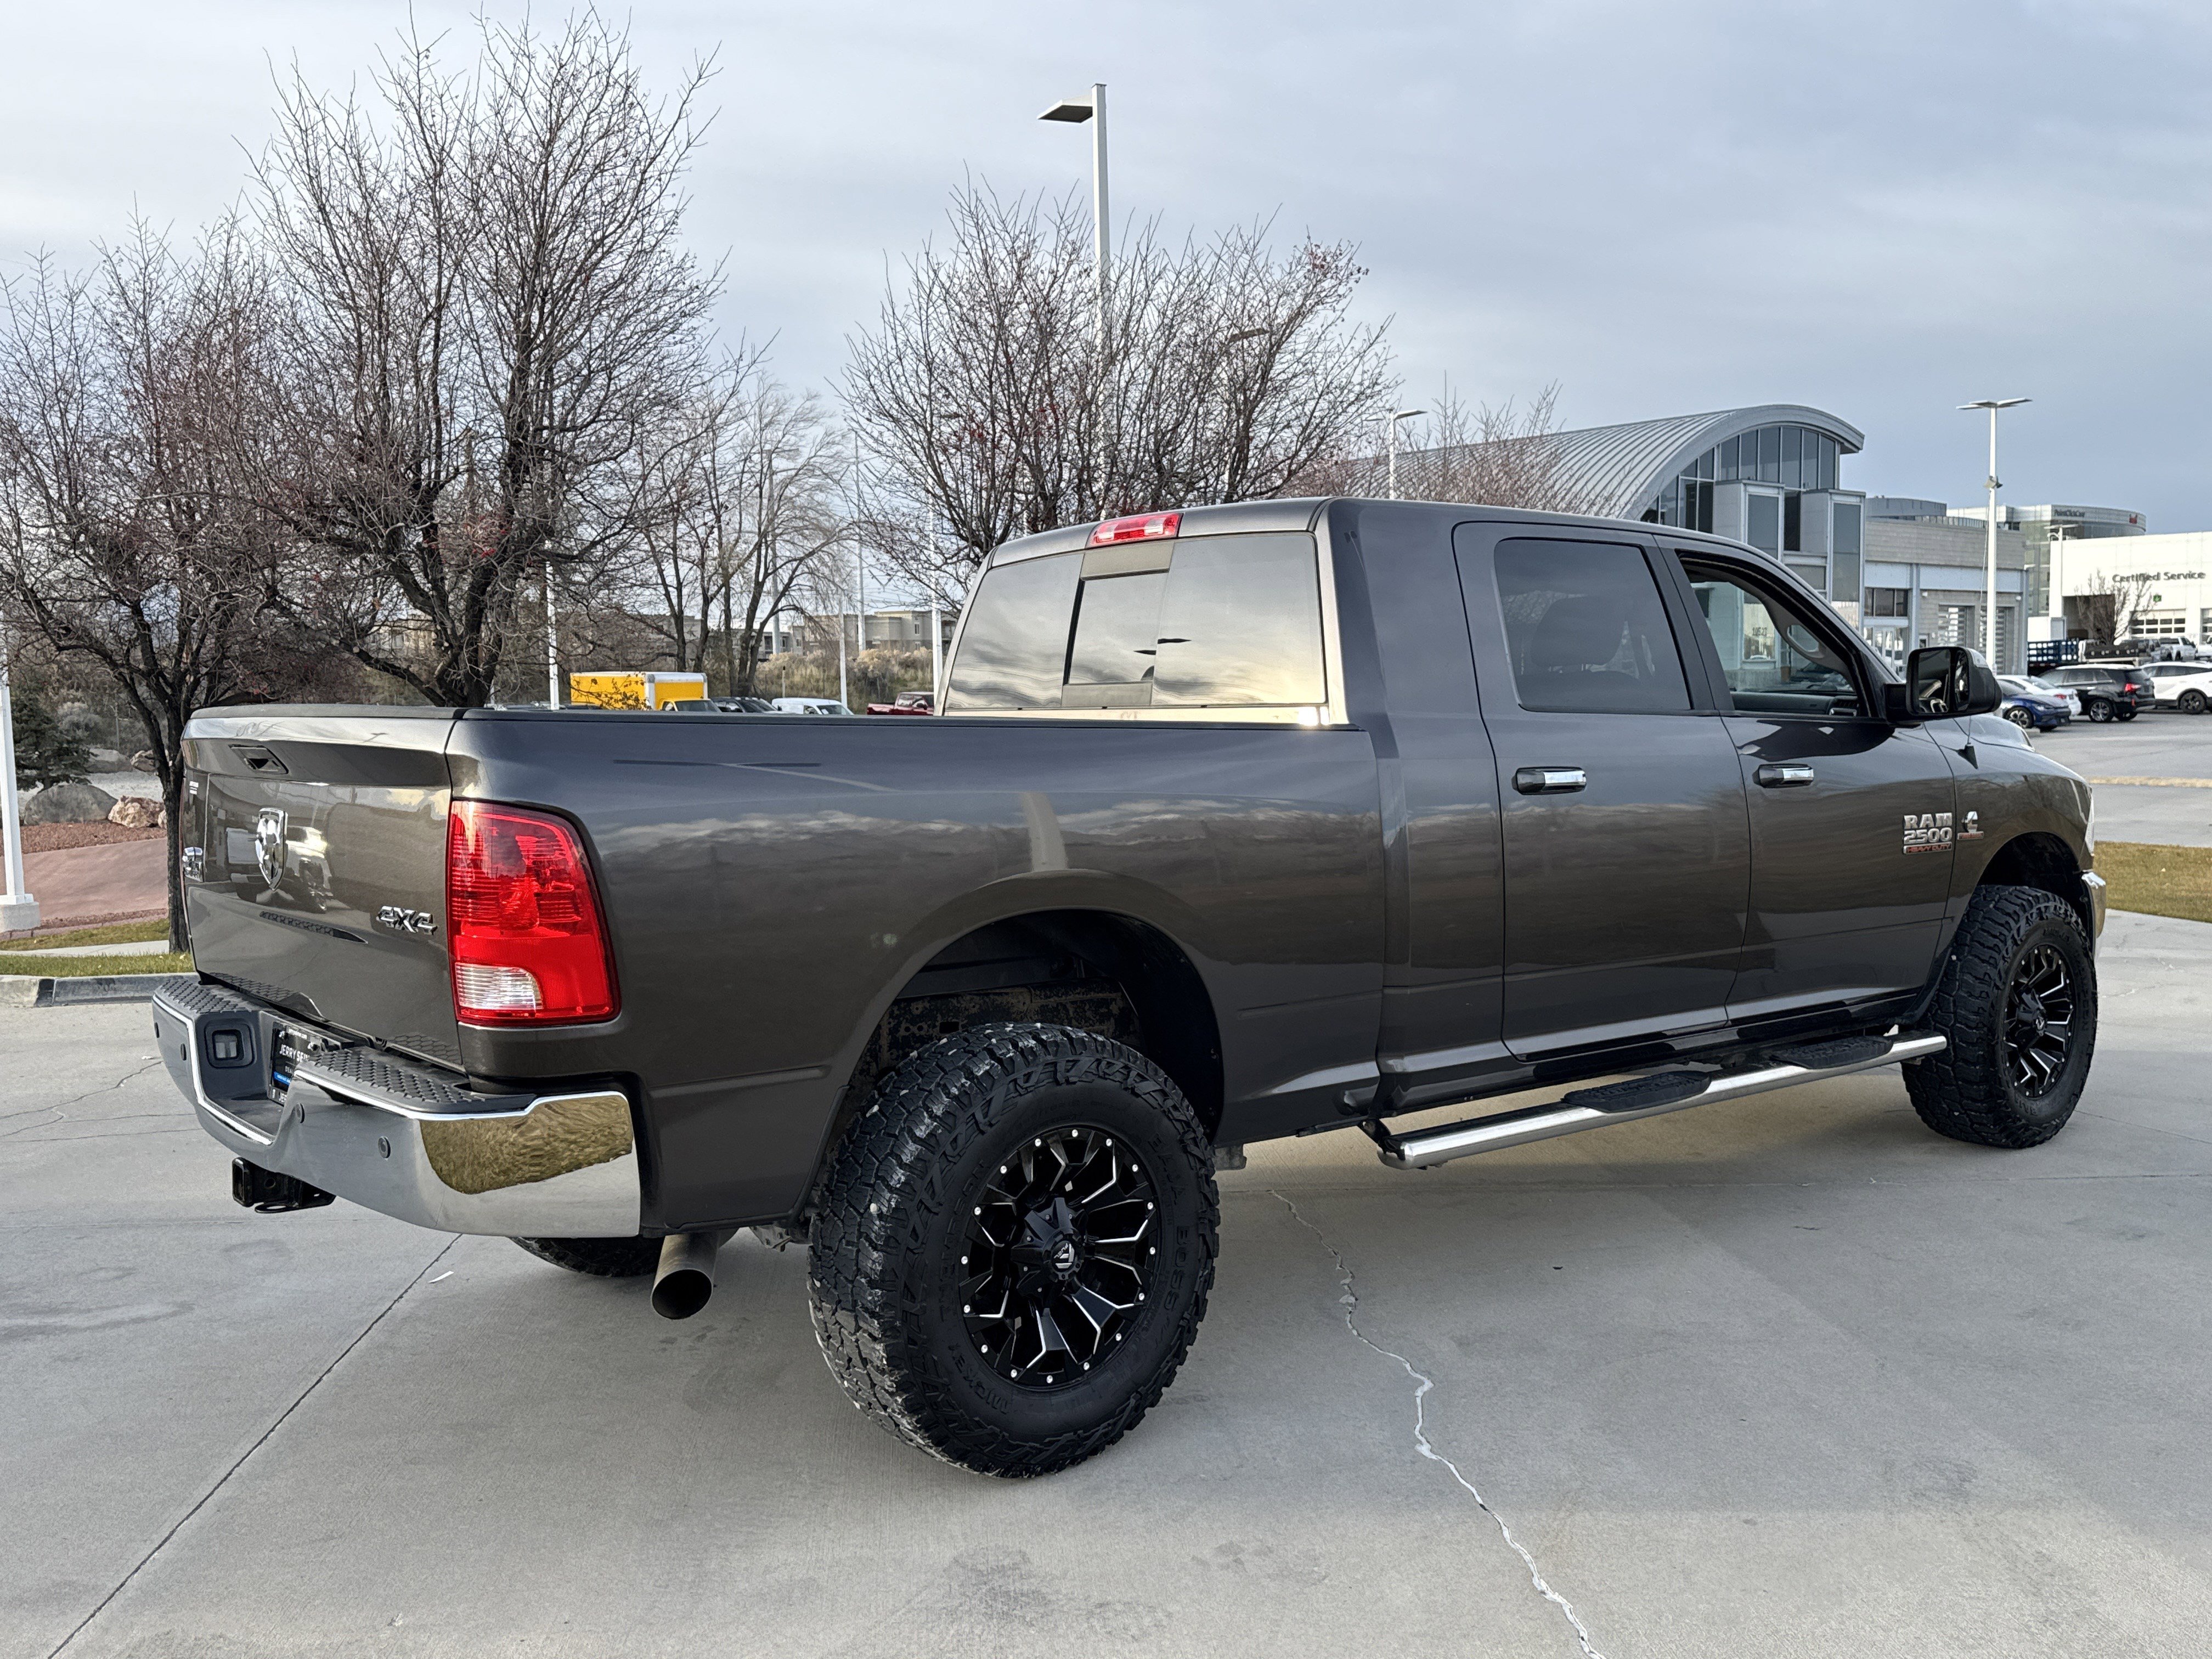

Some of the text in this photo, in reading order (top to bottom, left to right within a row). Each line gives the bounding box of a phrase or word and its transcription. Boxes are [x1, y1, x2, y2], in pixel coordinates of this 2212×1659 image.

[2112, 570, 2206, 583] Certified Service
[1903, 812, 1953, 829] RAM
[1903, 827, 1953, 844] 2500
[1907, 843, 1951, 854] HEAVY DUTY
[280, 1043, 297, 1060] JERRY
[1164, 1226, 1189, 1312] BOSS
